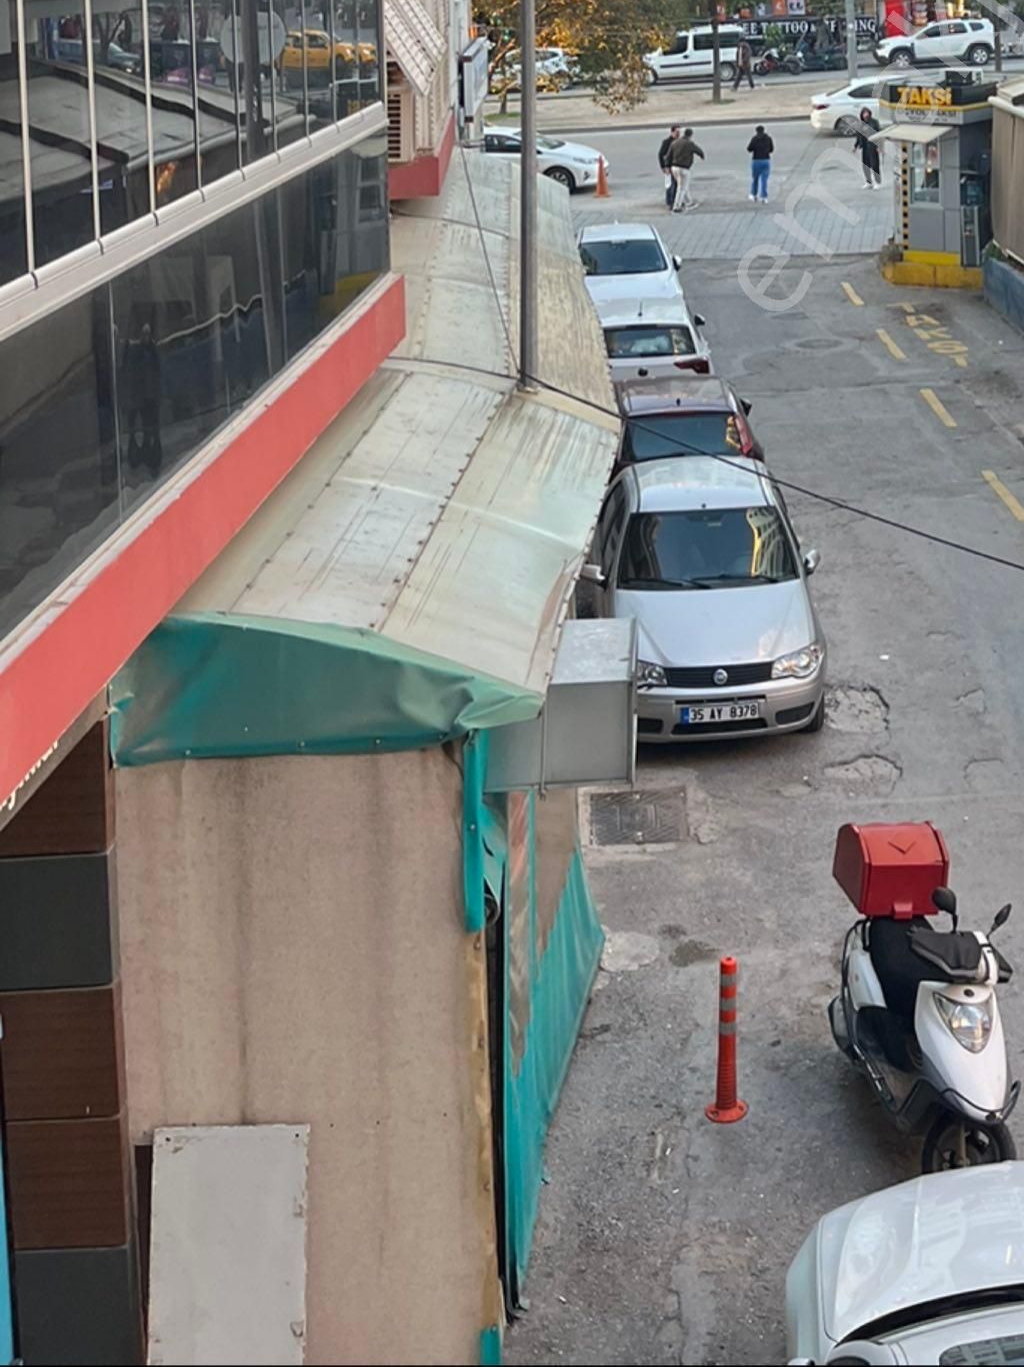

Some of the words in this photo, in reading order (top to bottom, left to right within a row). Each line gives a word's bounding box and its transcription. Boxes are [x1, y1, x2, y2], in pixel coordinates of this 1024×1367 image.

[690, 708, 704, 721] 35
[710, 707, 723, 721] AY
[729, 704, 758, 719] 8378
